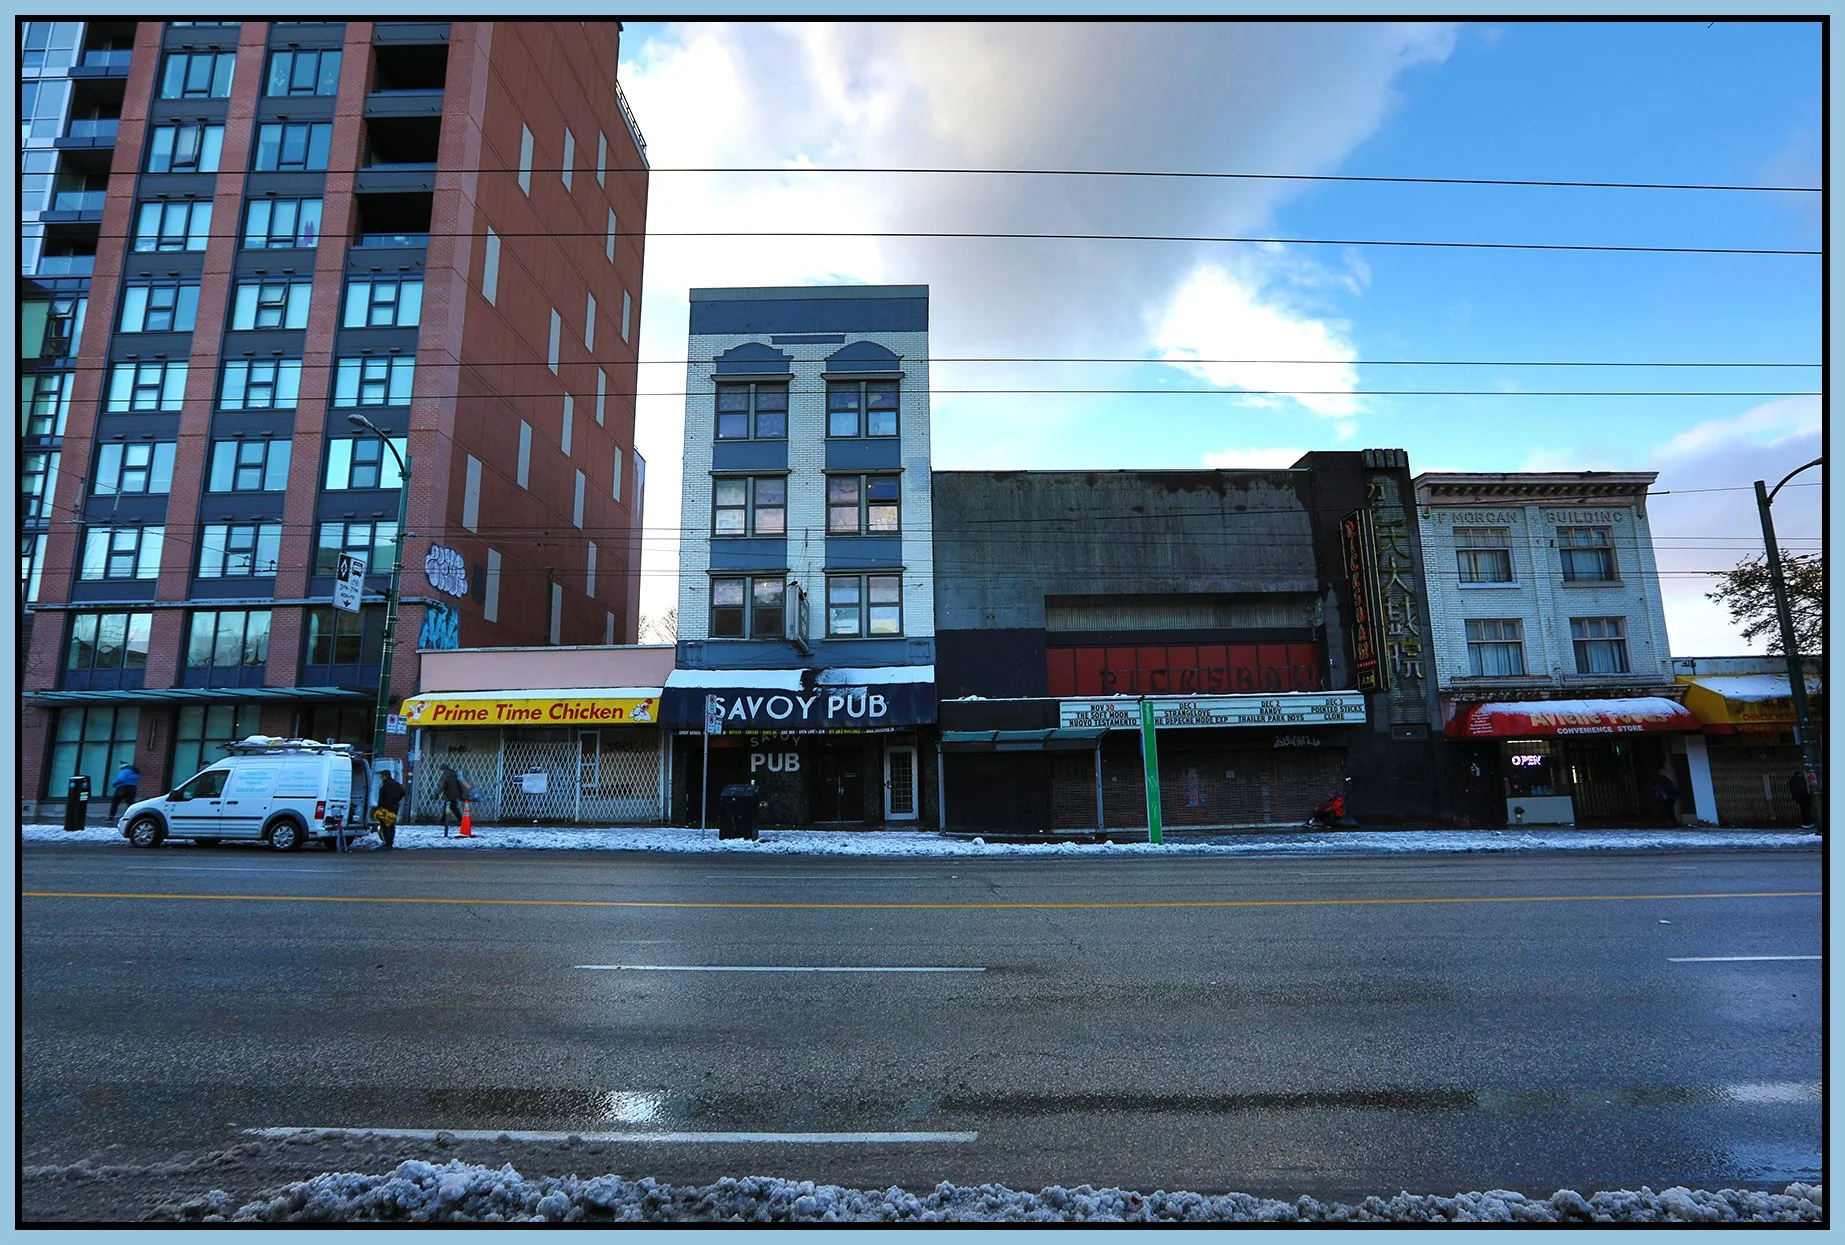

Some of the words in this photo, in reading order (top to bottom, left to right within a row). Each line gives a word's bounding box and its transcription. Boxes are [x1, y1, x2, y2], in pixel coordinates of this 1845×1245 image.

[1452, 511, 1519, 524] MORGAN
[1546, 511, 1625, 524] BUILDING
[432, 703, 489, 721] Prime
[495, 703, 543, 721] Time
[548, 701, 624, 720] Chicken
[715, 695, 817, 720] SAVOY
[828, 695, 888, 719] PUB
[1106, 703, 1115, 711] 30
[1164, 709, 1211, 717] STRANGELOVE
[1238, 714, 1266, 722] TRAILER
[1268, 714, 1285, 722] PARK
[1287, 713, 1305, 721] BOYS
[1742, 713, 1774, 721] CHINESE
[1069, 719, 1092, 727] NUOVO
[1094, 718, 1137, 726] TESTAMENTO
[1165, 716, 1194, 724] DEPECHE
[1557, 726, 1613, 735] CONVENIENCE
[1617, 724, 1644, 734] STORE
[750, 752, 800, 772] PUB
[1511, 754, 1543, 767] OPEN
